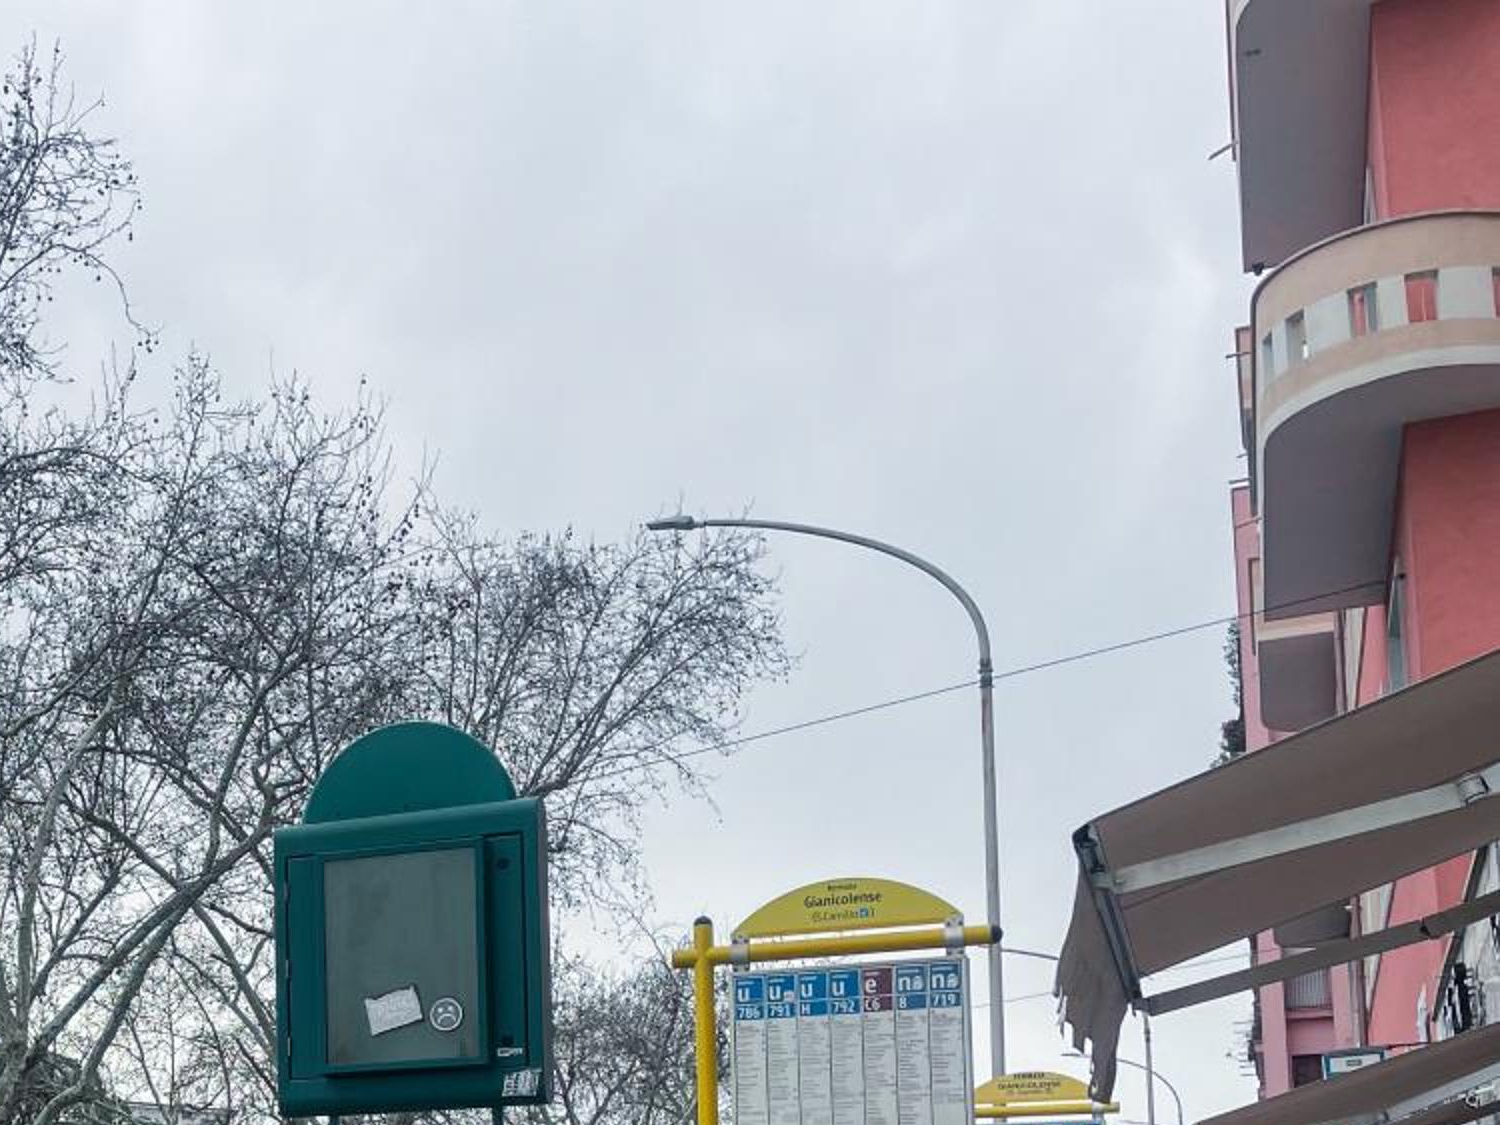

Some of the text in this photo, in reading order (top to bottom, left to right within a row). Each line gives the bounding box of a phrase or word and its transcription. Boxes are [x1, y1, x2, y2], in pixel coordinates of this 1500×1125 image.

[803, 892, 883, 908] Gianicolense
[737, 986, 750, 1002] u
[769, 984, 781, 1001] u
[801, 983, 813, 998] u
[833, 980, 845, 996] u
[865, 979, 877, 993] e
[737, 994, 955, 1020] 786 791 H 792 C6 8 719
